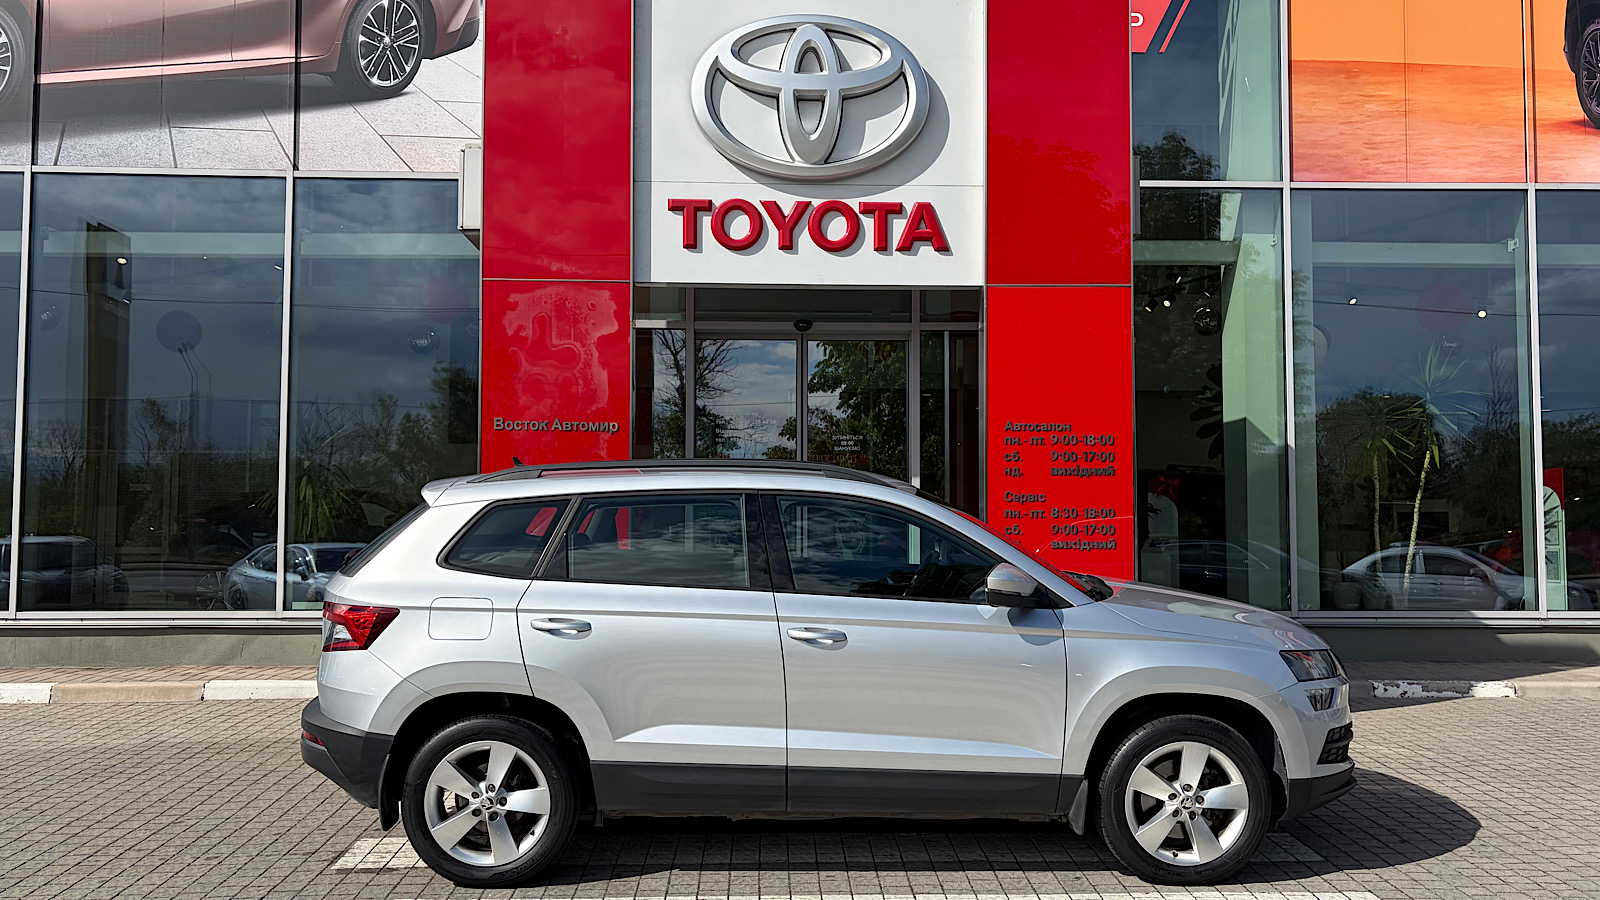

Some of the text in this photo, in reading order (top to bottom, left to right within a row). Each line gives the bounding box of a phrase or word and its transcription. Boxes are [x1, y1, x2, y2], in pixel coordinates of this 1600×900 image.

[667, 197, 951, 252] TOYOTA
[493, 416, 619, 436] Восток Автомир
[1004, 420, 1071, 432] Автосалон
[1050, 434, 1115, 446] 9:00-18:00
[1004, 450, 1116, 462] сб. 9:00-17:00
[1004, 464, 1116, 478] нд. вихідний
[1004, 490, 1047, 505] Сервіс
[1050, 507, 1116, 519] 8:30-18:00
[1004, 523, 1116, 536] сб. 9:00-17:00
[1051, 538, 1117, 551] вихідний
